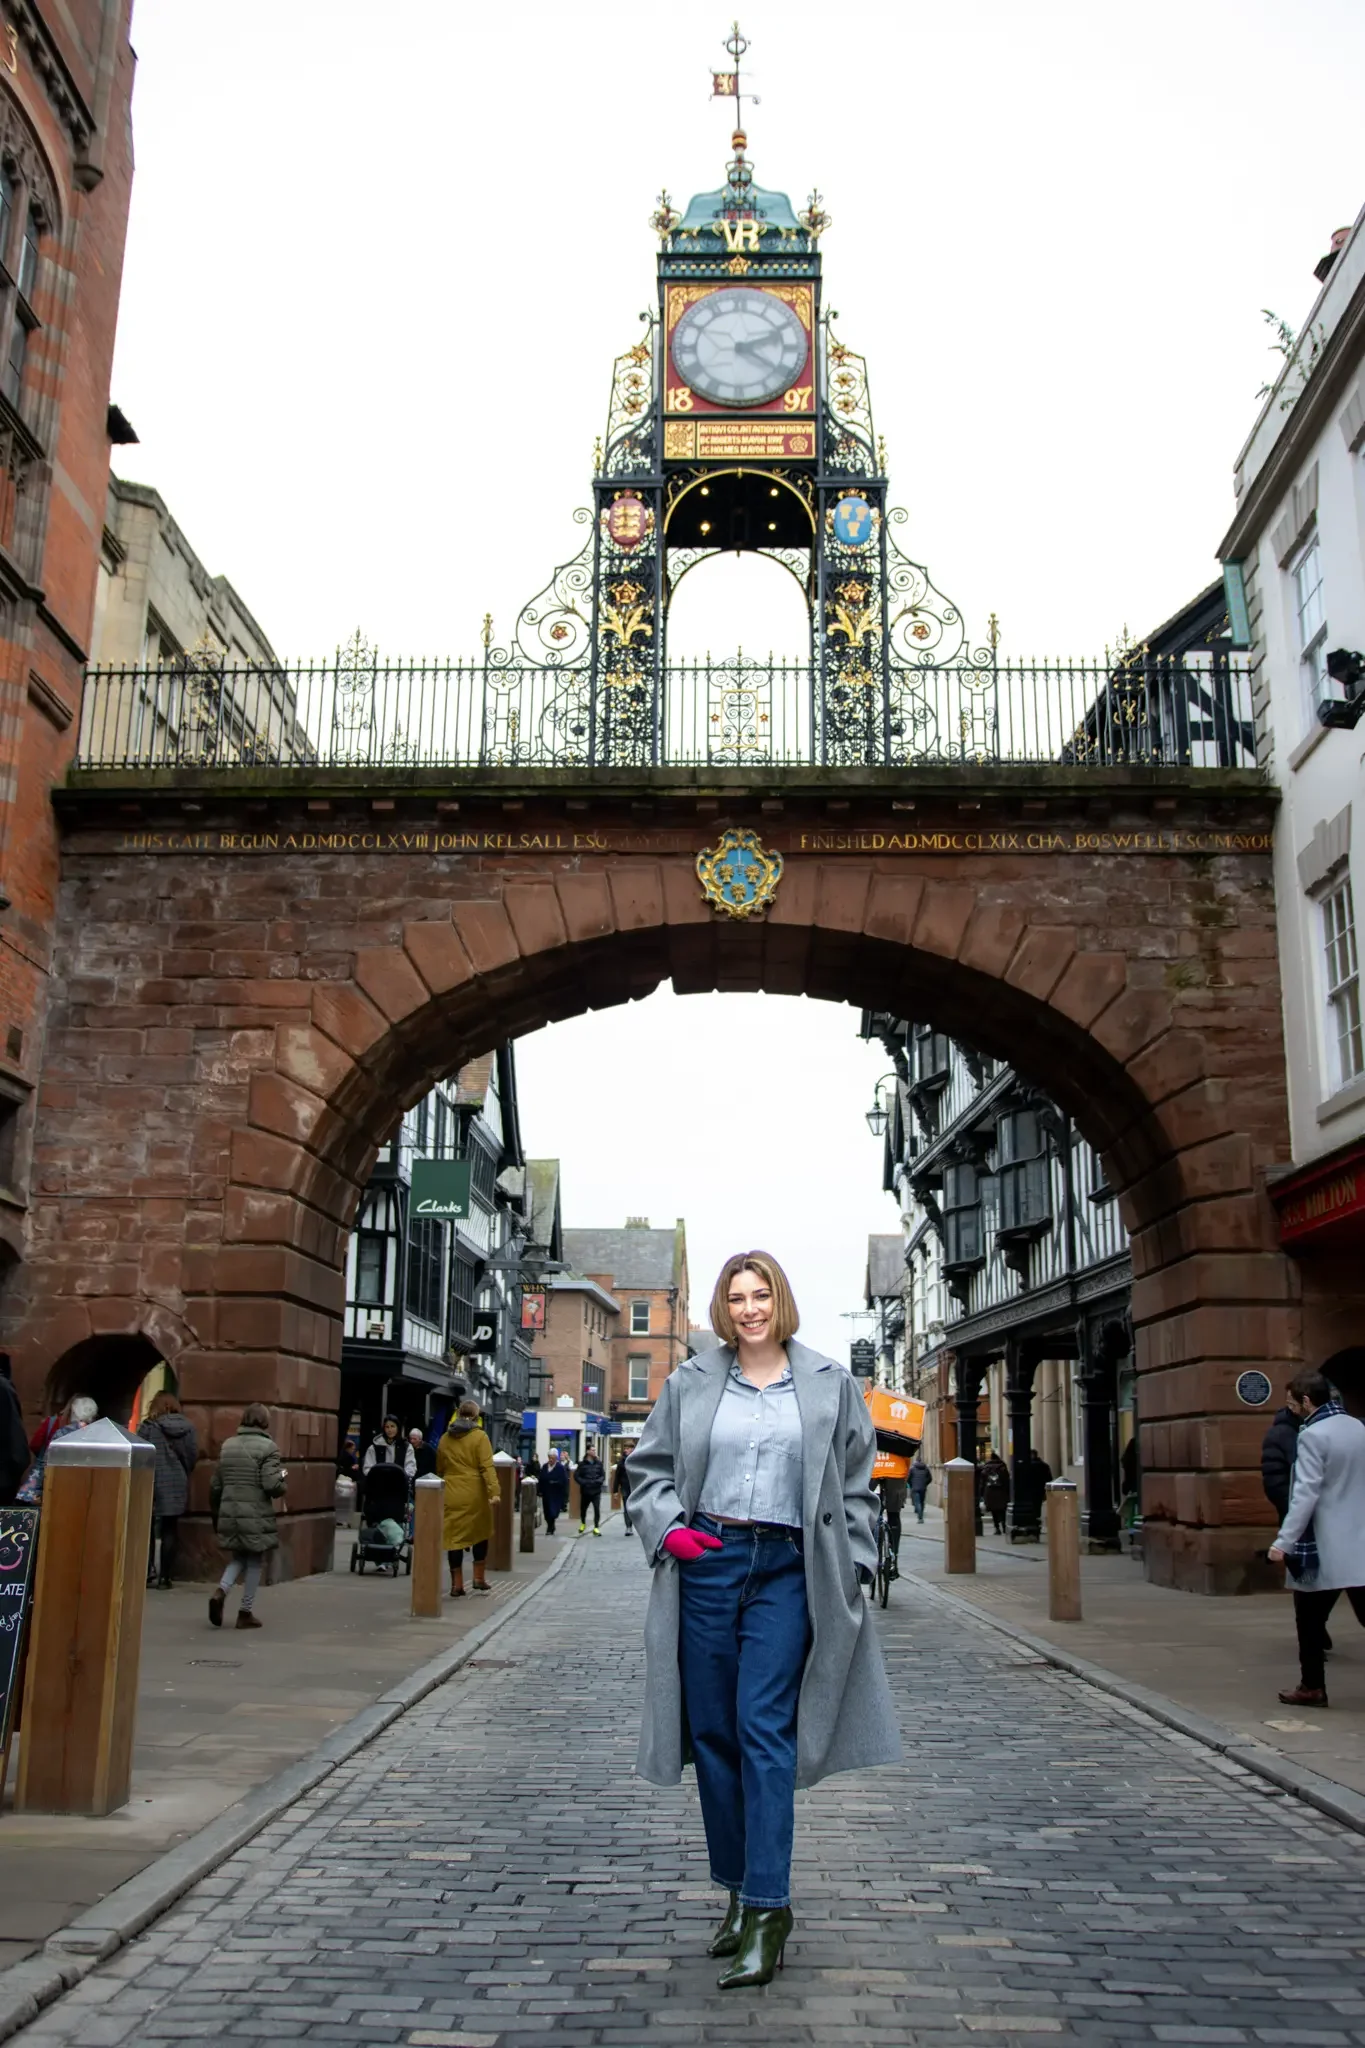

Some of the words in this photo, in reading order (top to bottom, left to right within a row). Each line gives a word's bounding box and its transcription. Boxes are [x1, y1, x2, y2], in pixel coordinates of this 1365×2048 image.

[721, 219, 760, 252] VR
[667, 387, 694, 412] 18
[784, 386, 813, 412] 97
[220, 834, 279, 849] BEGUN
[432, 834, 479, 852] JOHN
[484, 834, 568, 849] KELSALL
[801, 834, 885, 849] FINISHED
[416, 1199, 463, 1213] Clarks
[472, 1325, 493, 1340] JD
